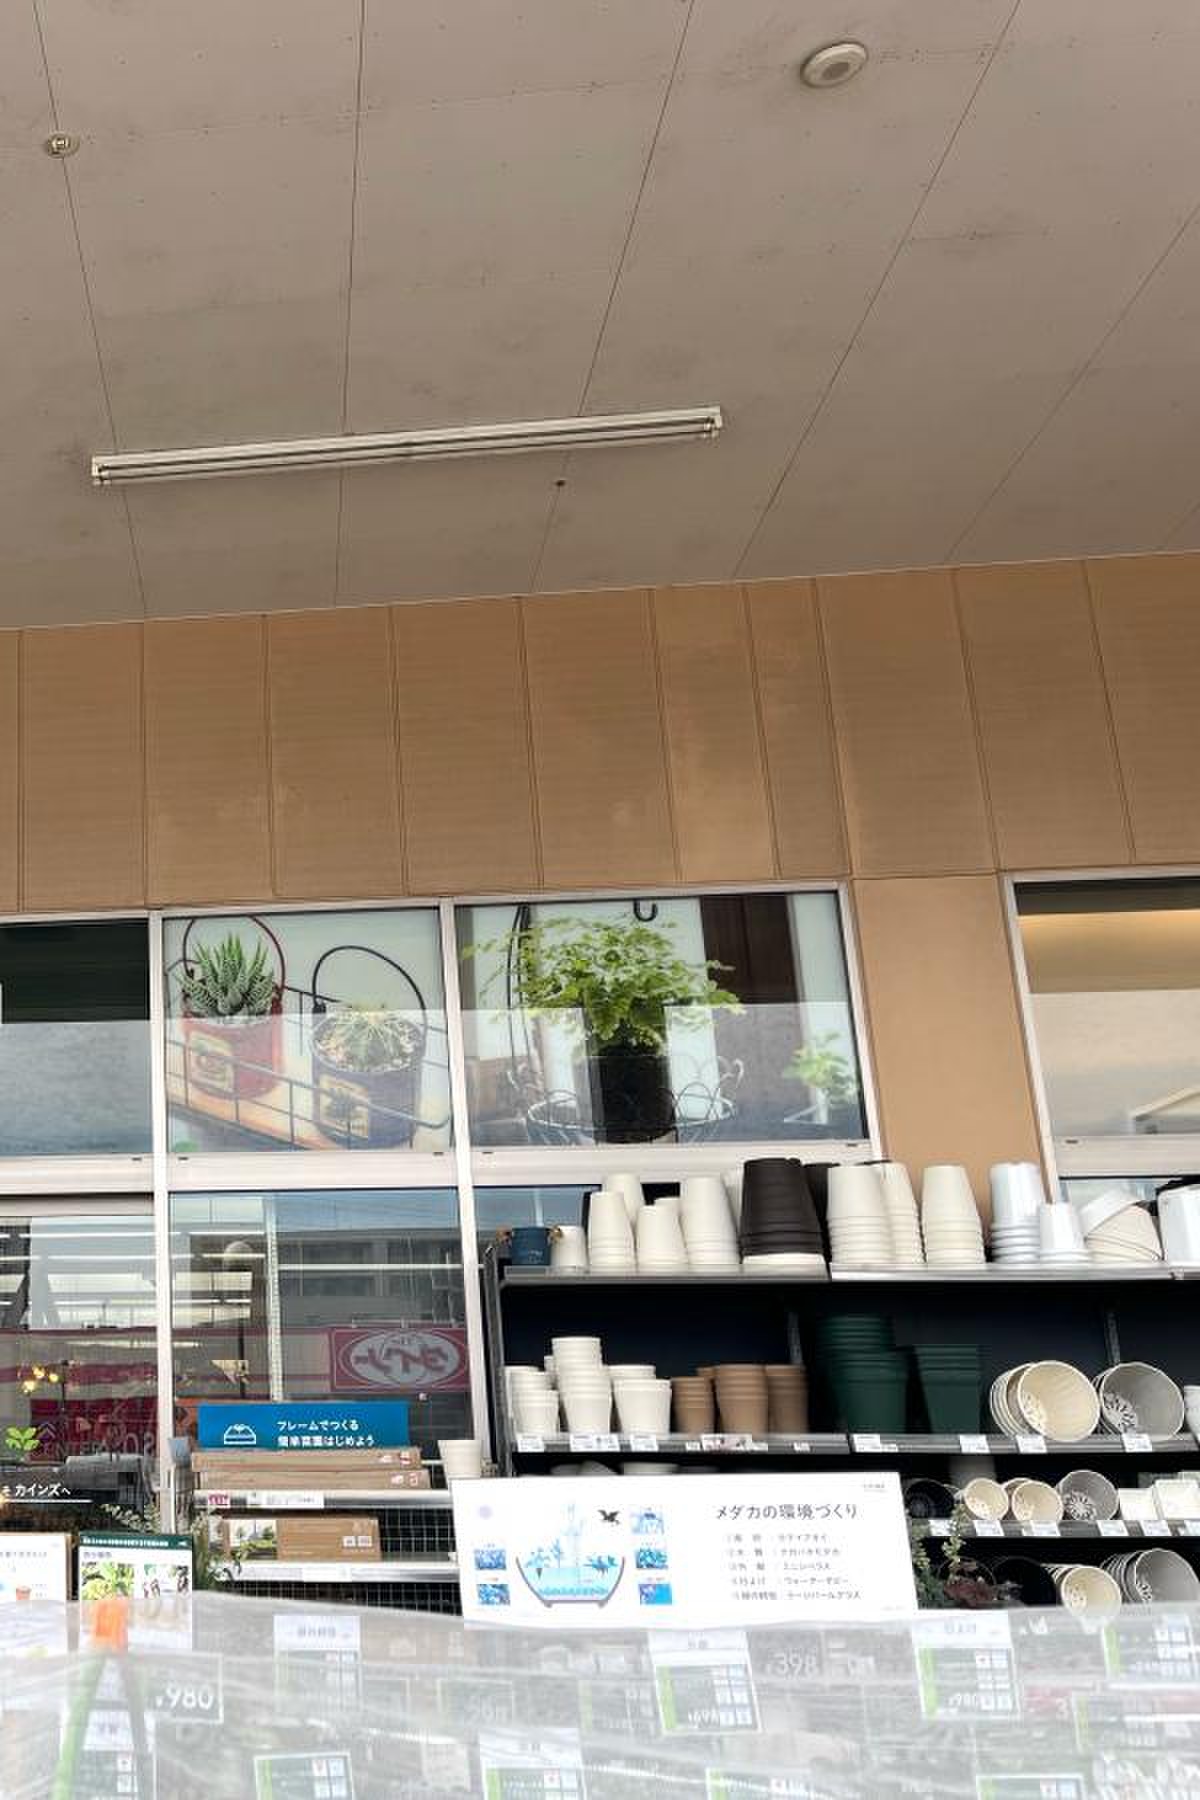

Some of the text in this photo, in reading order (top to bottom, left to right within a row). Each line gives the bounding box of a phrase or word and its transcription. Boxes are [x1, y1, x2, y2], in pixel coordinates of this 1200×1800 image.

[276, 1419, 360, 1432] フレームでつくる
[277, 1434, 376, 1448] 簡単菜園はじめよう
[15, 1483, 72, 1498] カインズへ
[715, 1503, 858, 1521] メダカの環境づくり
